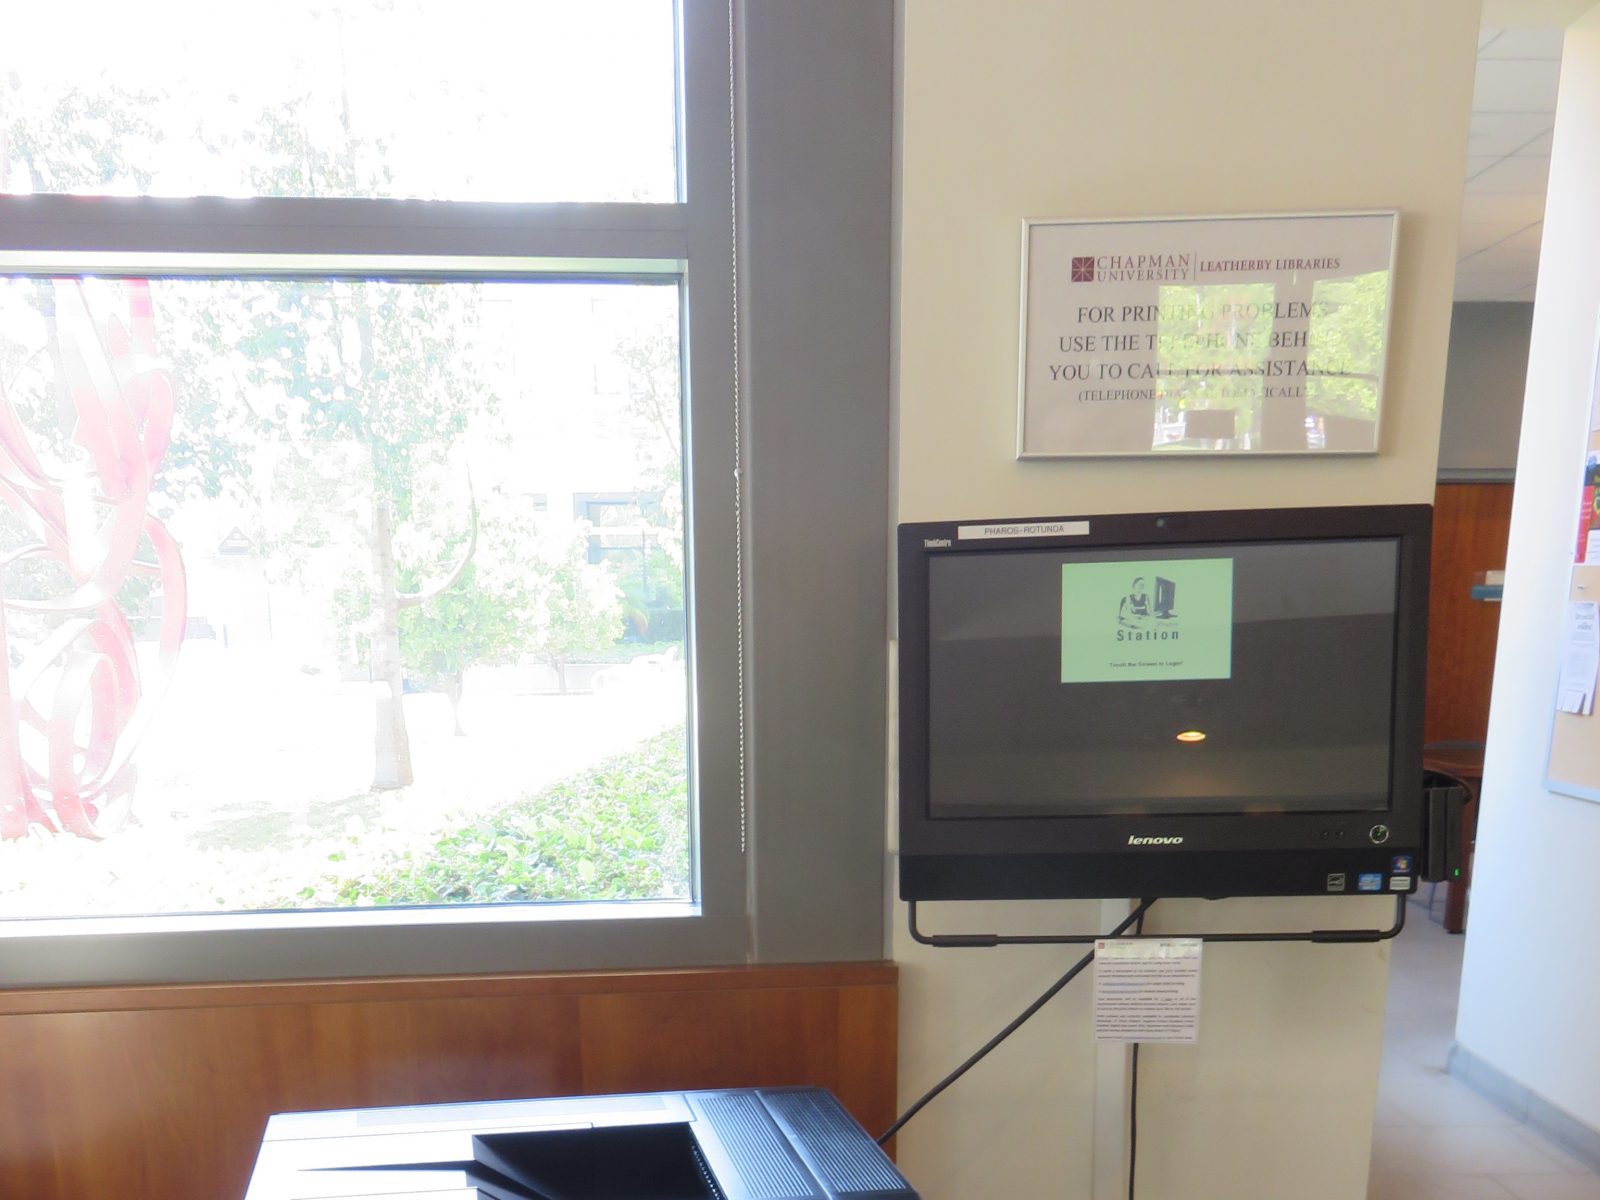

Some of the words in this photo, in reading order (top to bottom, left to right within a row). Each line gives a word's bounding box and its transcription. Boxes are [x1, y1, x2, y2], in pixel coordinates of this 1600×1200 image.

[1097, 254, 1190, 269] CHAPMAN
[1200, 259, 1272, 272] LEATHERBY
[1276, 258, 1341, 270] LIBRARIES
[1098, 268, 1189, 282] UNIVERSITY
[1077, 306, 1115, 323] FOR
[1060, 336, 1096, 352] USE
[1102, 335, 1140, 350] THE
[1050, 365, 1089, 380] YOU
[1098, 364, 1122, 379] TO
[1117, 629, 1179, 641] Station
[1128, 835, 1183, 845] lenovo
